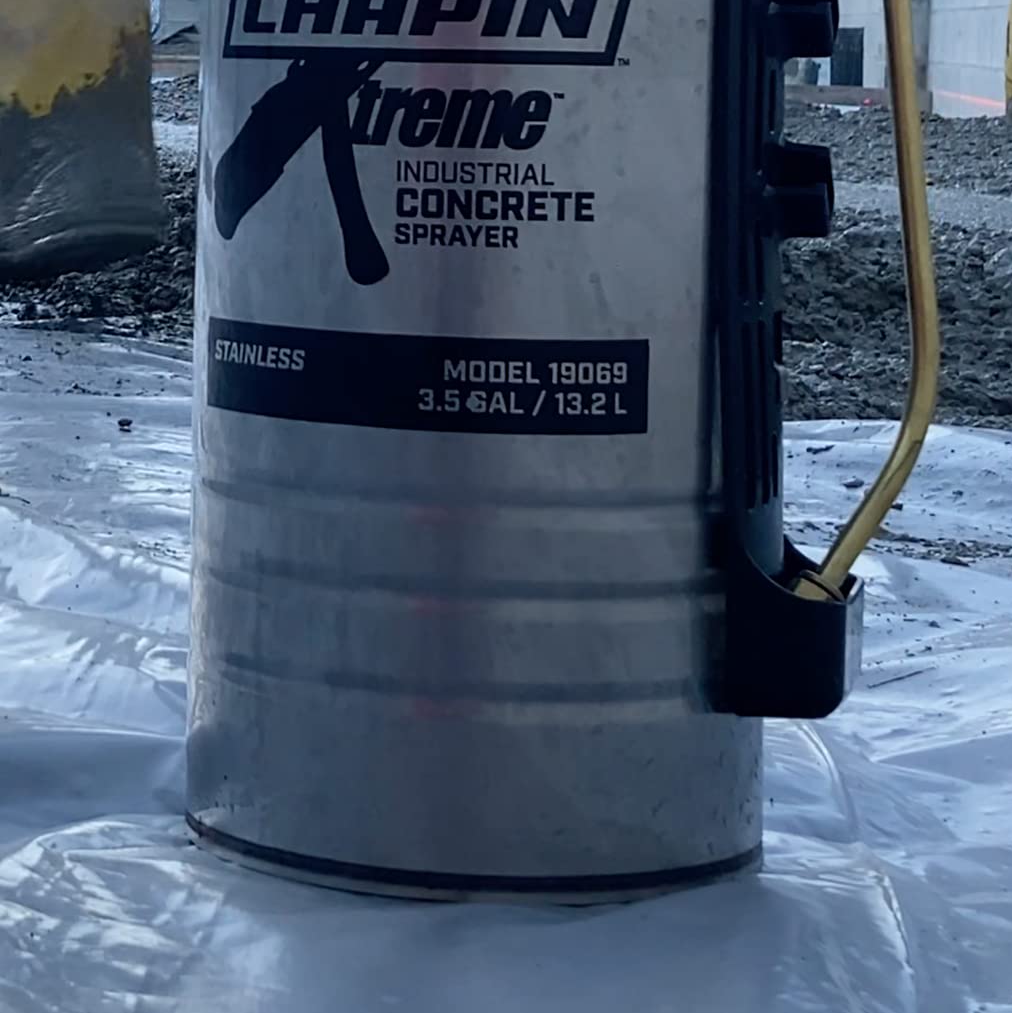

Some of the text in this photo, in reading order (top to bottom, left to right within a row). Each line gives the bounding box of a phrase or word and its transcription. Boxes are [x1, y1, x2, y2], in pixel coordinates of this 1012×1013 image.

[396, 159, 555, 186] INDUSTRIAL
[395, 187, 595, 222] CONCRETE
[394, 222, 519, 249] SPRAYER
[214, 338, 306, 371] STAINLESS
[443, 359, 628, 385] MODEL 19069
[417, 388, 461, 412] 3.5
[467, 390, 525, 415] GAL
[554, 392, 607, 416] 13.2
[614, 392, 628, 416] L
